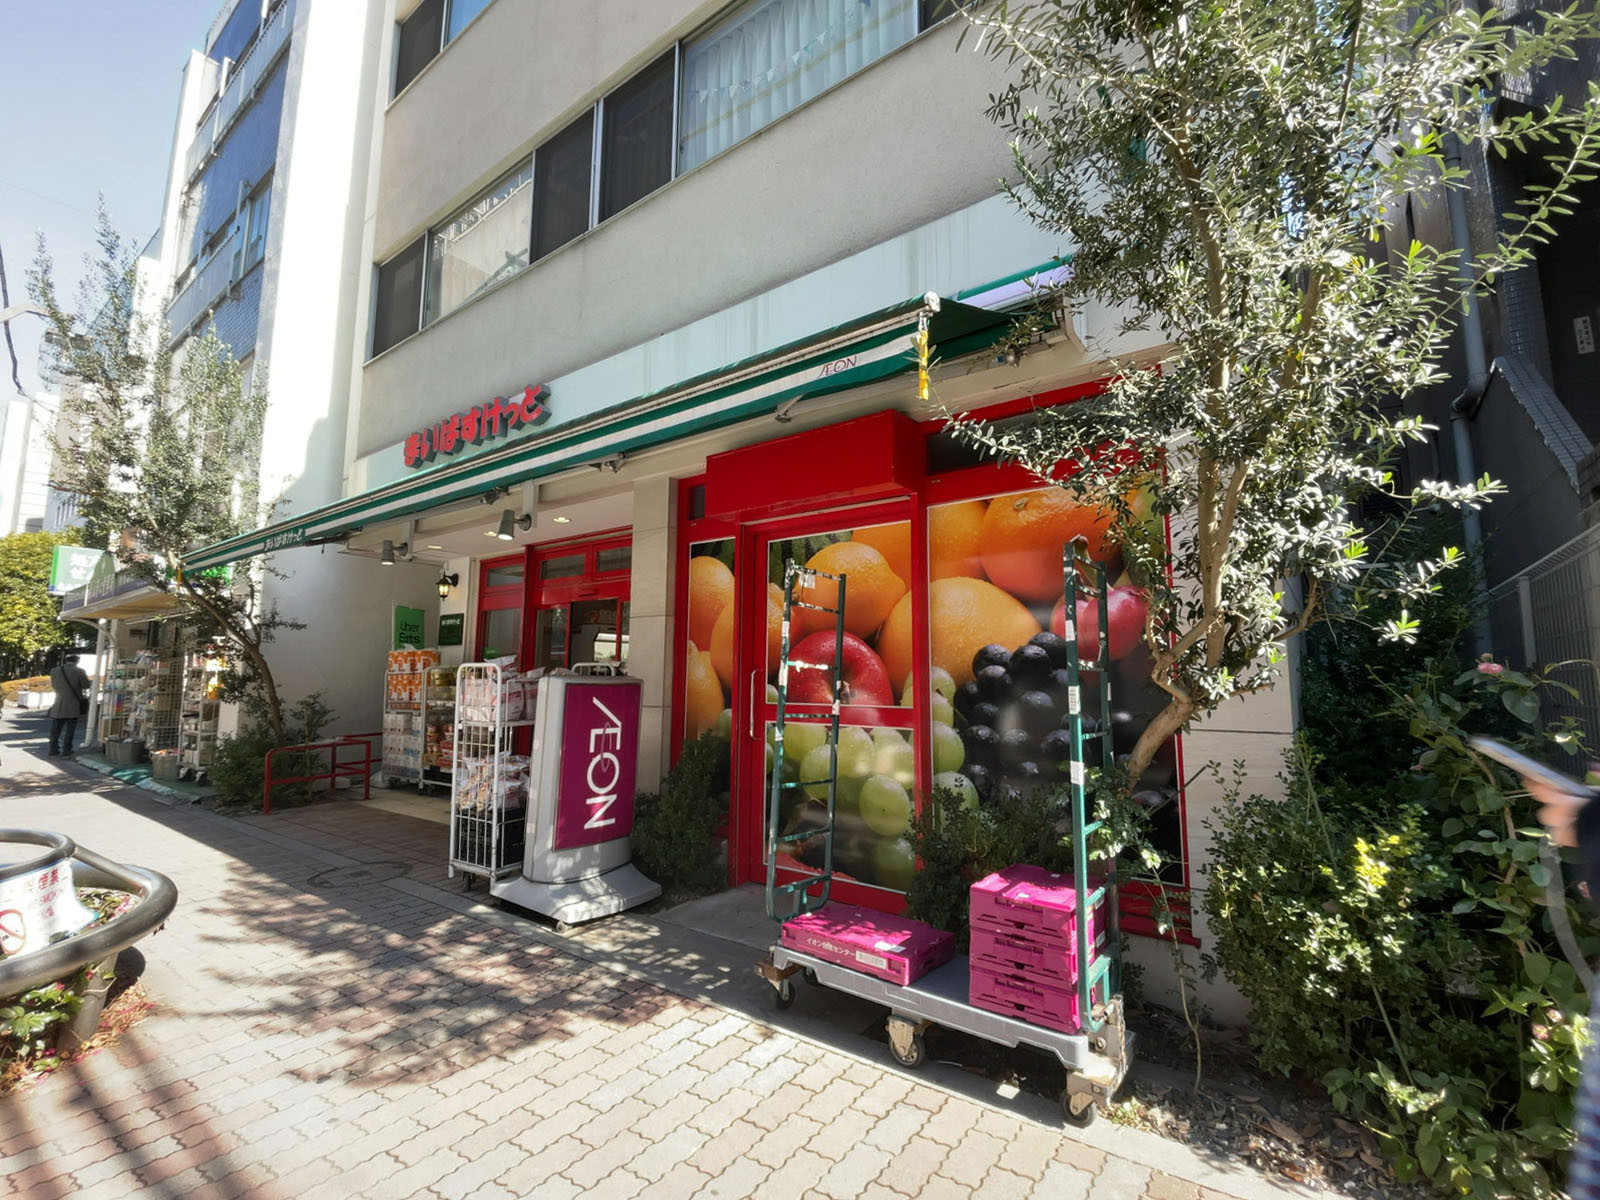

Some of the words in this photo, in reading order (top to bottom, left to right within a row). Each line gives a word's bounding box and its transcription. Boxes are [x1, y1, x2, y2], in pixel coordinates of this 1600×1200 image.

[403, 384, 544, 467] まいばすけっと
[400, 620, 419, 632] Uber
[400, 632, 420, 644] Eats
